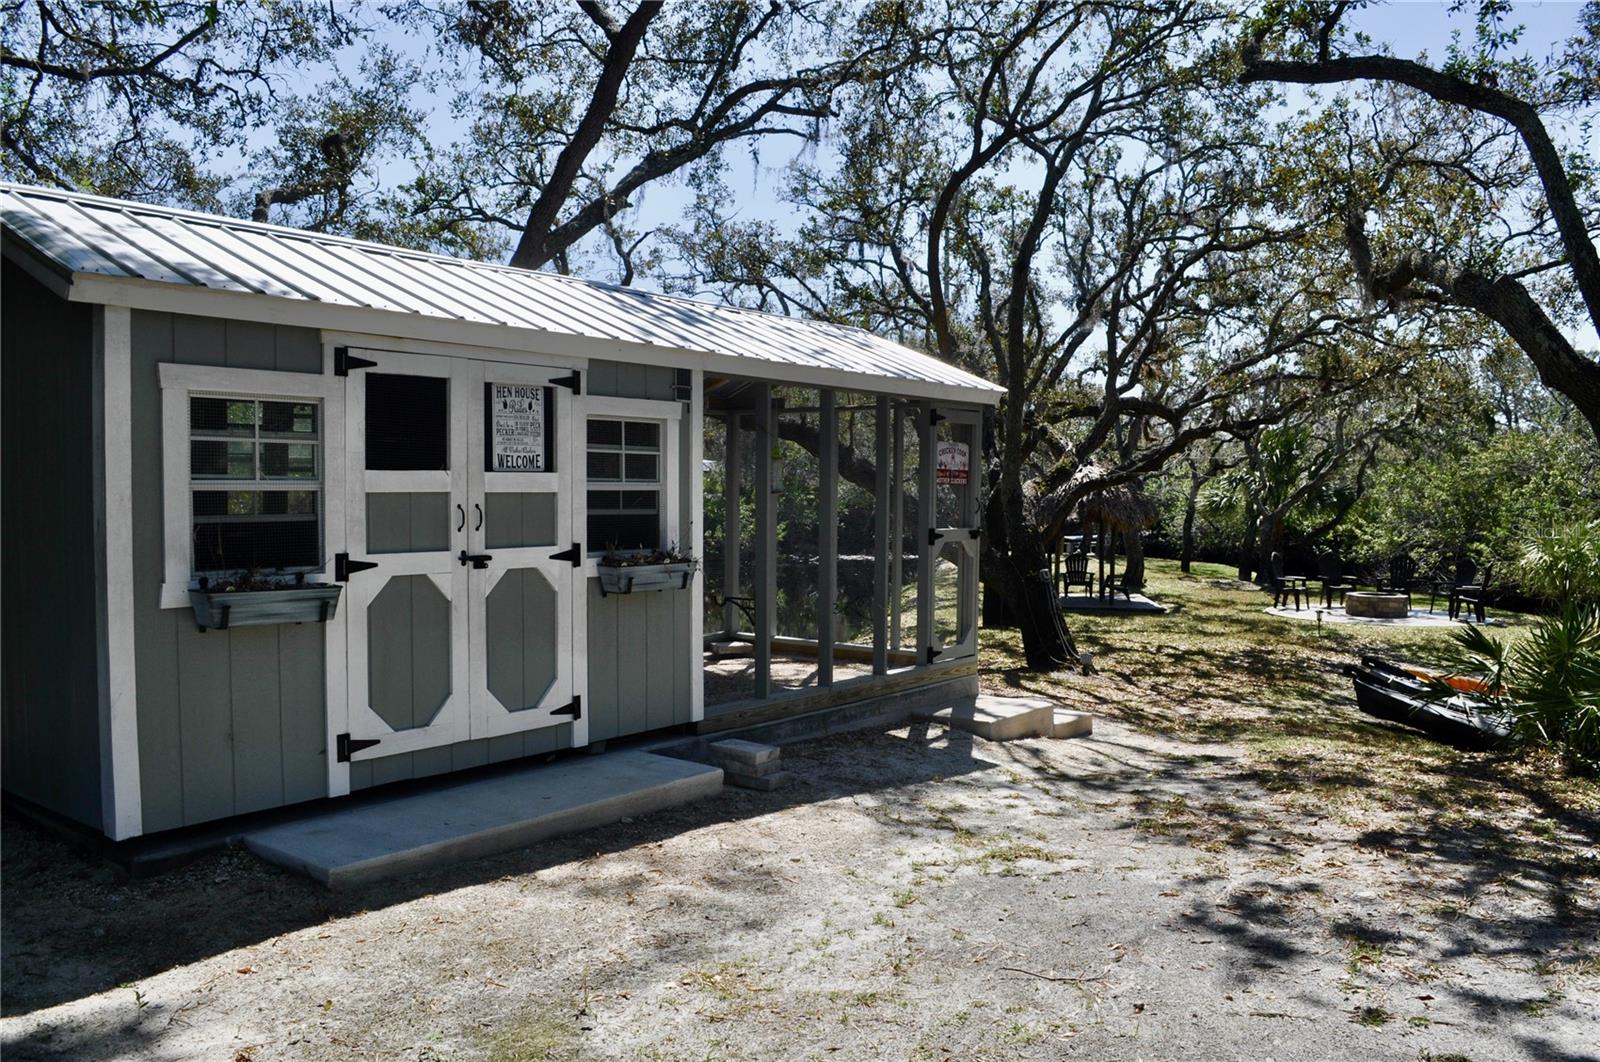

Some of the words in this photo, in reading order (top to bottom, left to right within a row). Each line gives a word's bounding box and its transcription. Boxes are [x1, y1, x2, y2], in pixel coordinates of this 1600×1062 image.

[496, 386, 512, 399] HEN
[515, 387, 540, 401] HOUSE
[496, 428, 514, 436] PECKER
[938, 447, 956, 456] CHICKEN
[497, 453, 541, 469] WELCOME
